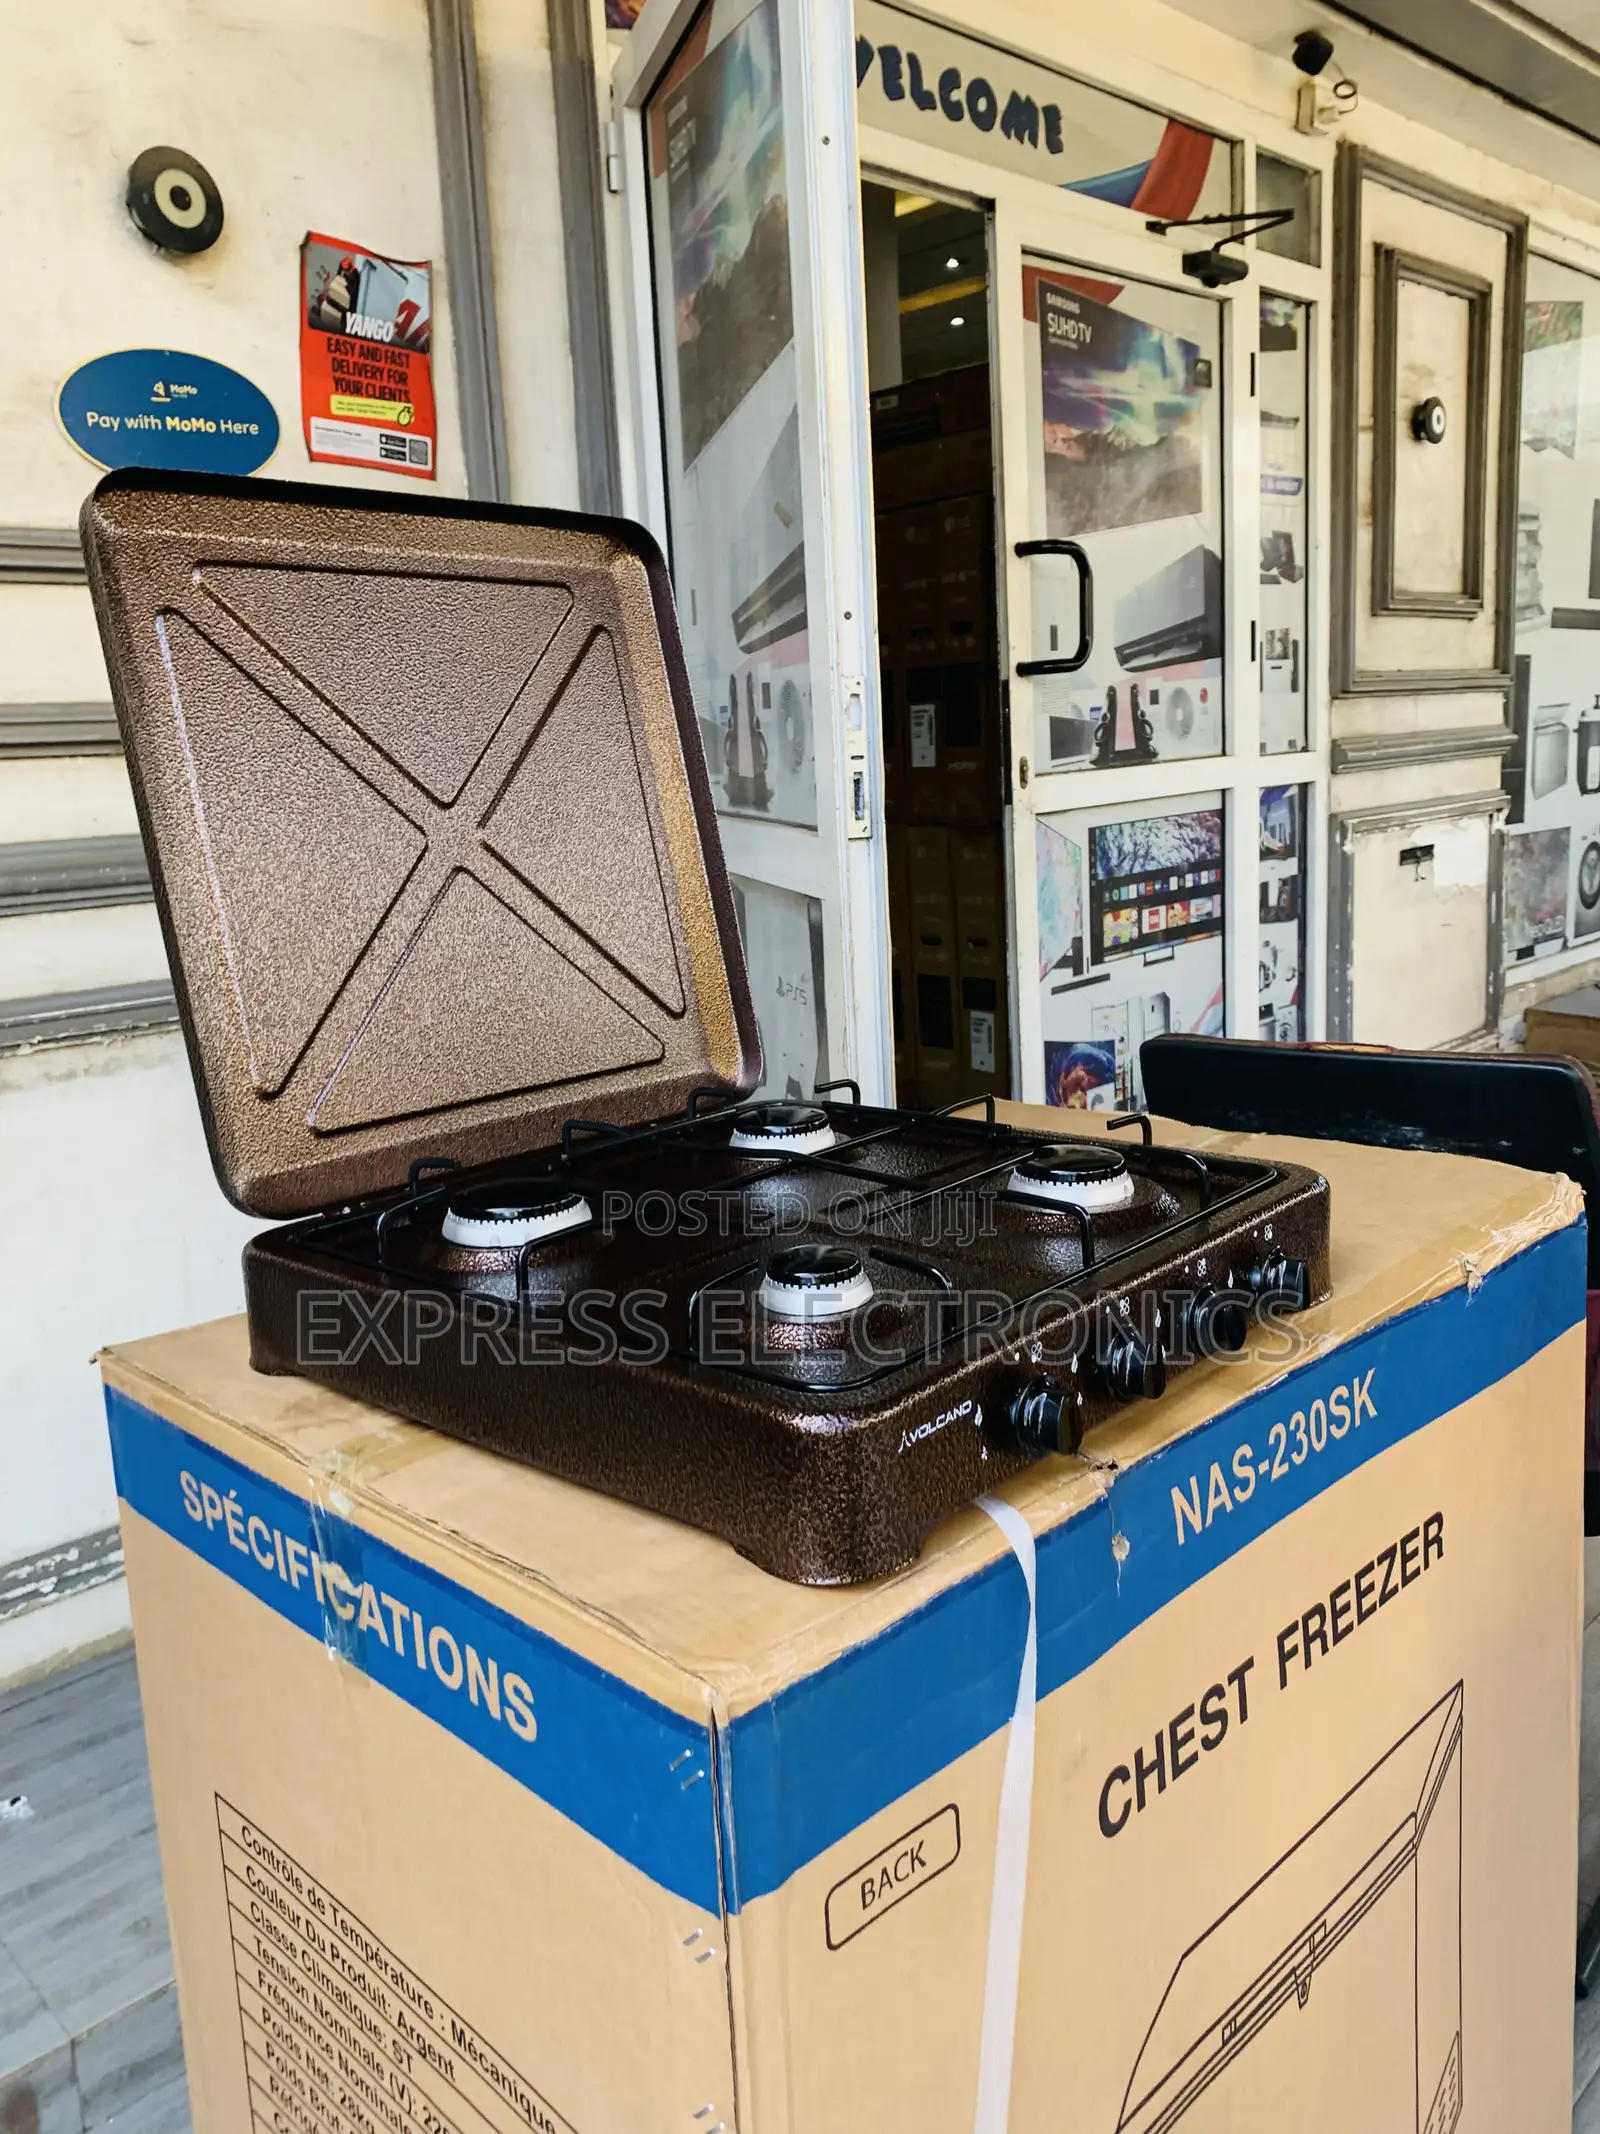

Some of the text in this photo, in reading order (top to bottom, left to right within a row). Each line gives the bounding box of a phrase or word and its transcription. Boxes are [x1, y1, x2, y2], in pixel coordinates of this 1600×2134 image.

[327, 337, 410, 369] EASY AND FAST
[345, 311, 395, 342] YANGO
[170, 384, 198, 395] MoMo
[332, 357, 408, 386] DELIVERY FOR
[333, 376, 411, 403] YOUR CLIENTS
[86, 411, 259, 435] Pay with MoMo Here
[909, 1399, 972, 1444] VOLCANO
[1170, 1367, 1378, 1546] NAS-230SK
[179, 1470, 538, 1743] SPÉCIFICATIONS
[1098, 1511, 1444, 1839] CHEST FREEZER
[860, 1839, 927, 1911] BACK
[241, 1825, 303, 1894] Contrôle
[307, 1886, 326, 1915] de
[329, 1902, 434, 2019] Température
[451, 2019, 557, 2134] Mécanique
[246, 1865, 456, 2083] Couleur Du Produit: Argent
[250, 1901, 298, 1959] Classe
[392, 2039, 414, 2074] ST
[253, 1935, 310, 2004] Tension
[313, 1993, 385, 2081] Nominale
[257, 1970, 334, 2061] Fréquence
[262, 2007, 302, 2060] Poids
[266, 2041, 306, 2096] Poids
